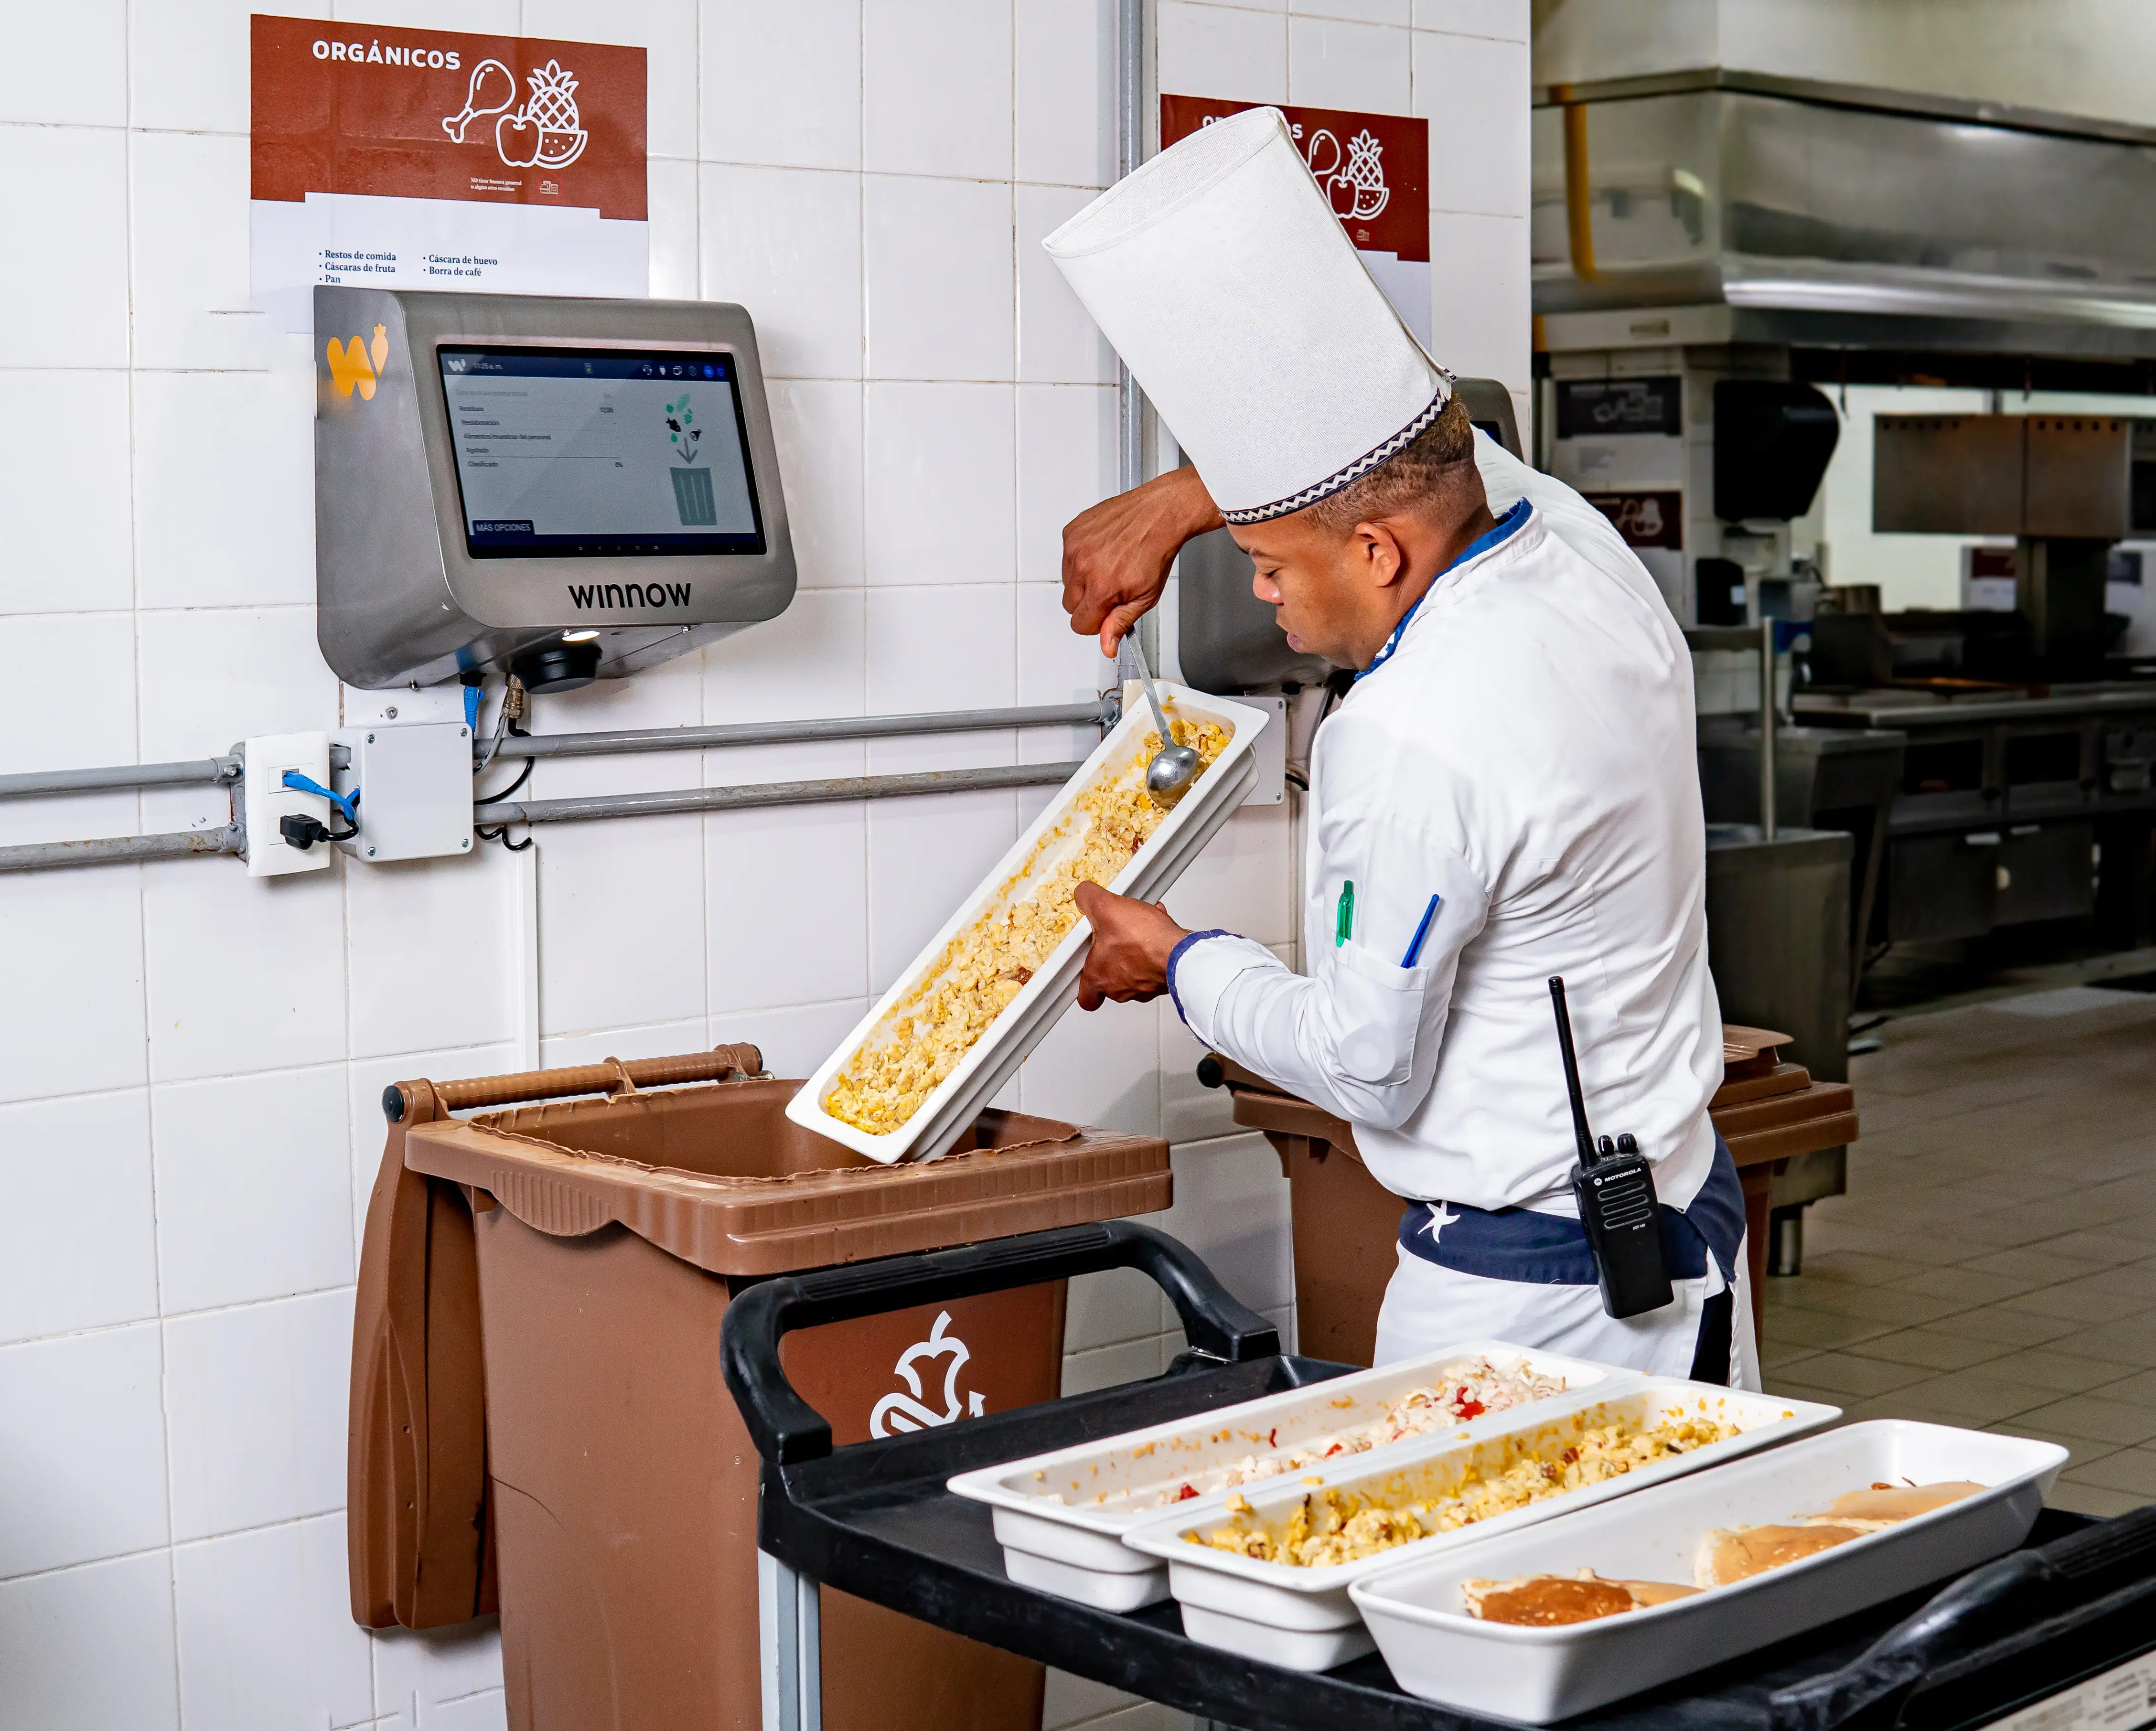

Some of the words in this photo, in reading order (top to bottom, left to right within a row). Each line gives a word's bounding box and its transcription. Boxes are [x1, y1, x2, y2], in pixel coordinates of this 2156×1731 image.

[312, 39, 461, 71] ORGÁNICOS
[325, 250, 352, 259] Restos
[354, 251, 364, 259] de
[366, 252, 396, 261] comida
[429, 254, 460, 264] Cáscara
[462, 255, 472, 264] de
[474, 256, 498, 265] huevo
[325, 262, 361, 272] Cáscaras
[363, 263, 373, 272] de
[375, 264, 396, 273] fruta
[429, 266, 451, 275] Borra
[454, 267, 463, 276] de
[465, 267, 482, 276] café
[325, 275, 341, 283] Pan
[476, 523, 493, 531] MÁS
[1604, 1167, 1641, 1182] MOTOROLA
